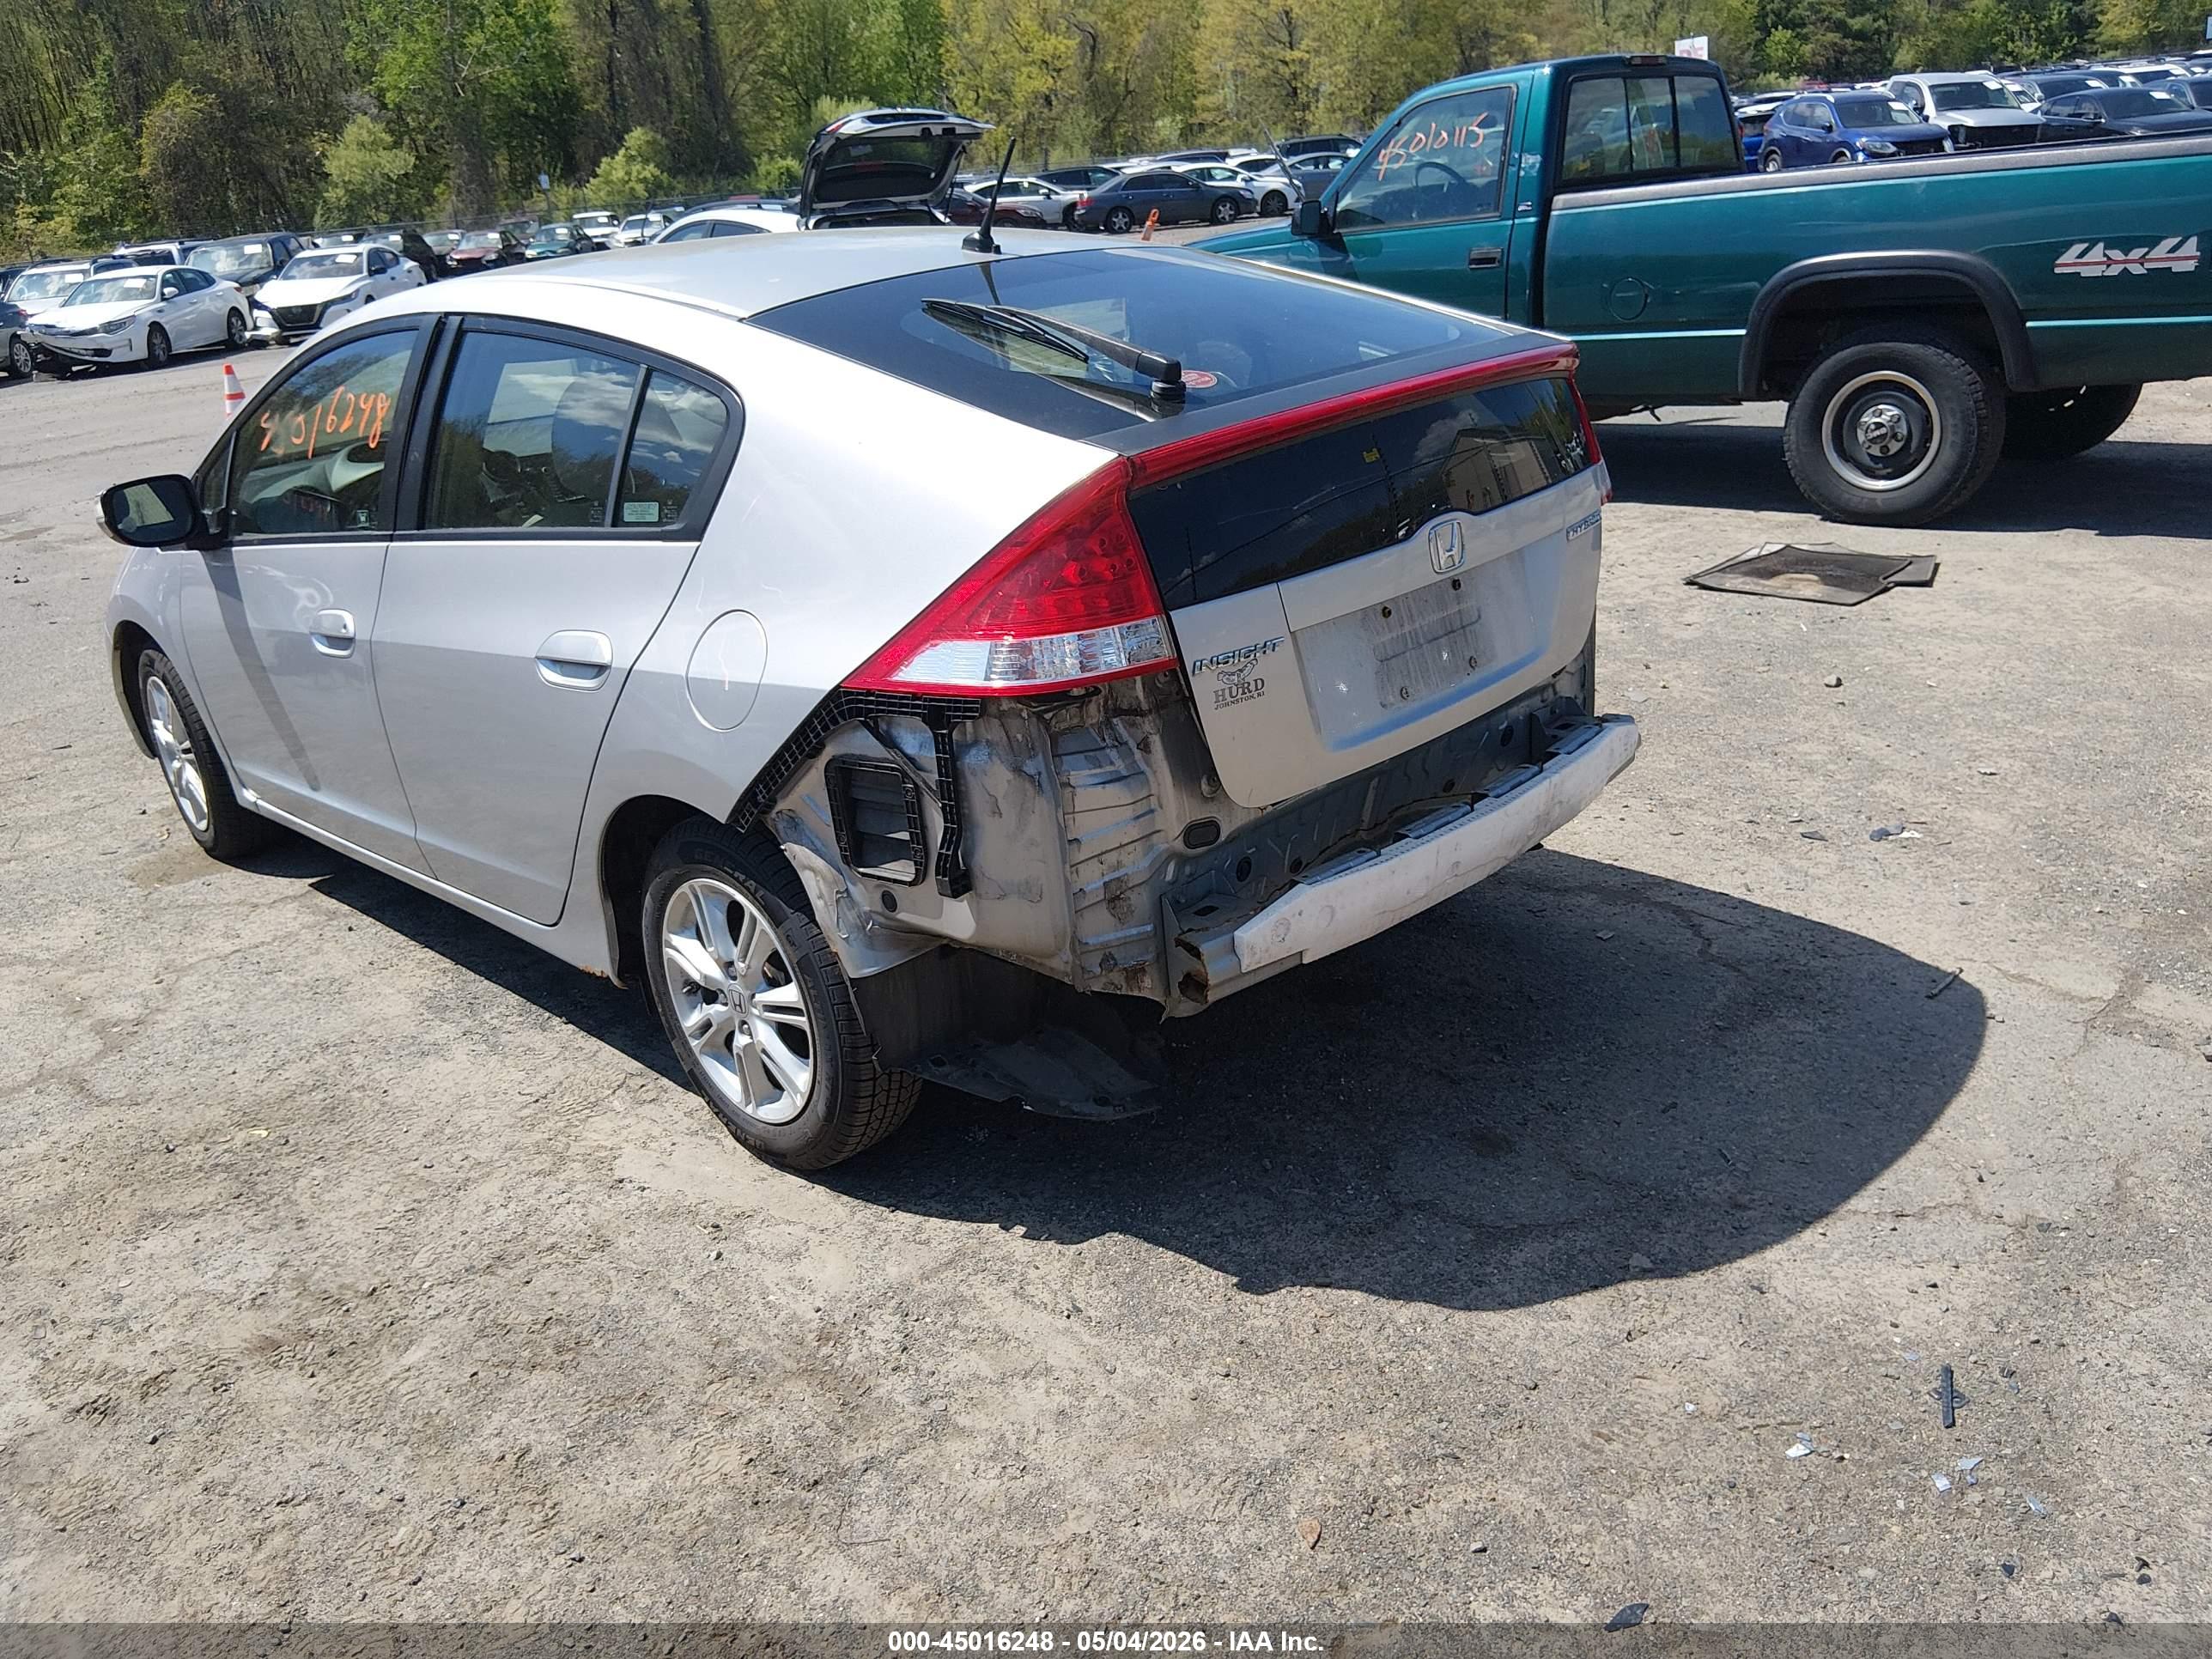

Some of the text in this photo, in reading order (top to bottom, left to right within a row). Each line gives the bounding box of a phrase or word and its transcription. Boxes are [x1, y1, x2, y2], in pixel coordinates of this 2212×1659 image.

[1378, 112, 1488, 181] 45010115
[260, 386, 391, 459] 4016248
[1192, 636, 1285, 676] INSIGHT
[1212, 678, 1265, 704] HURD
